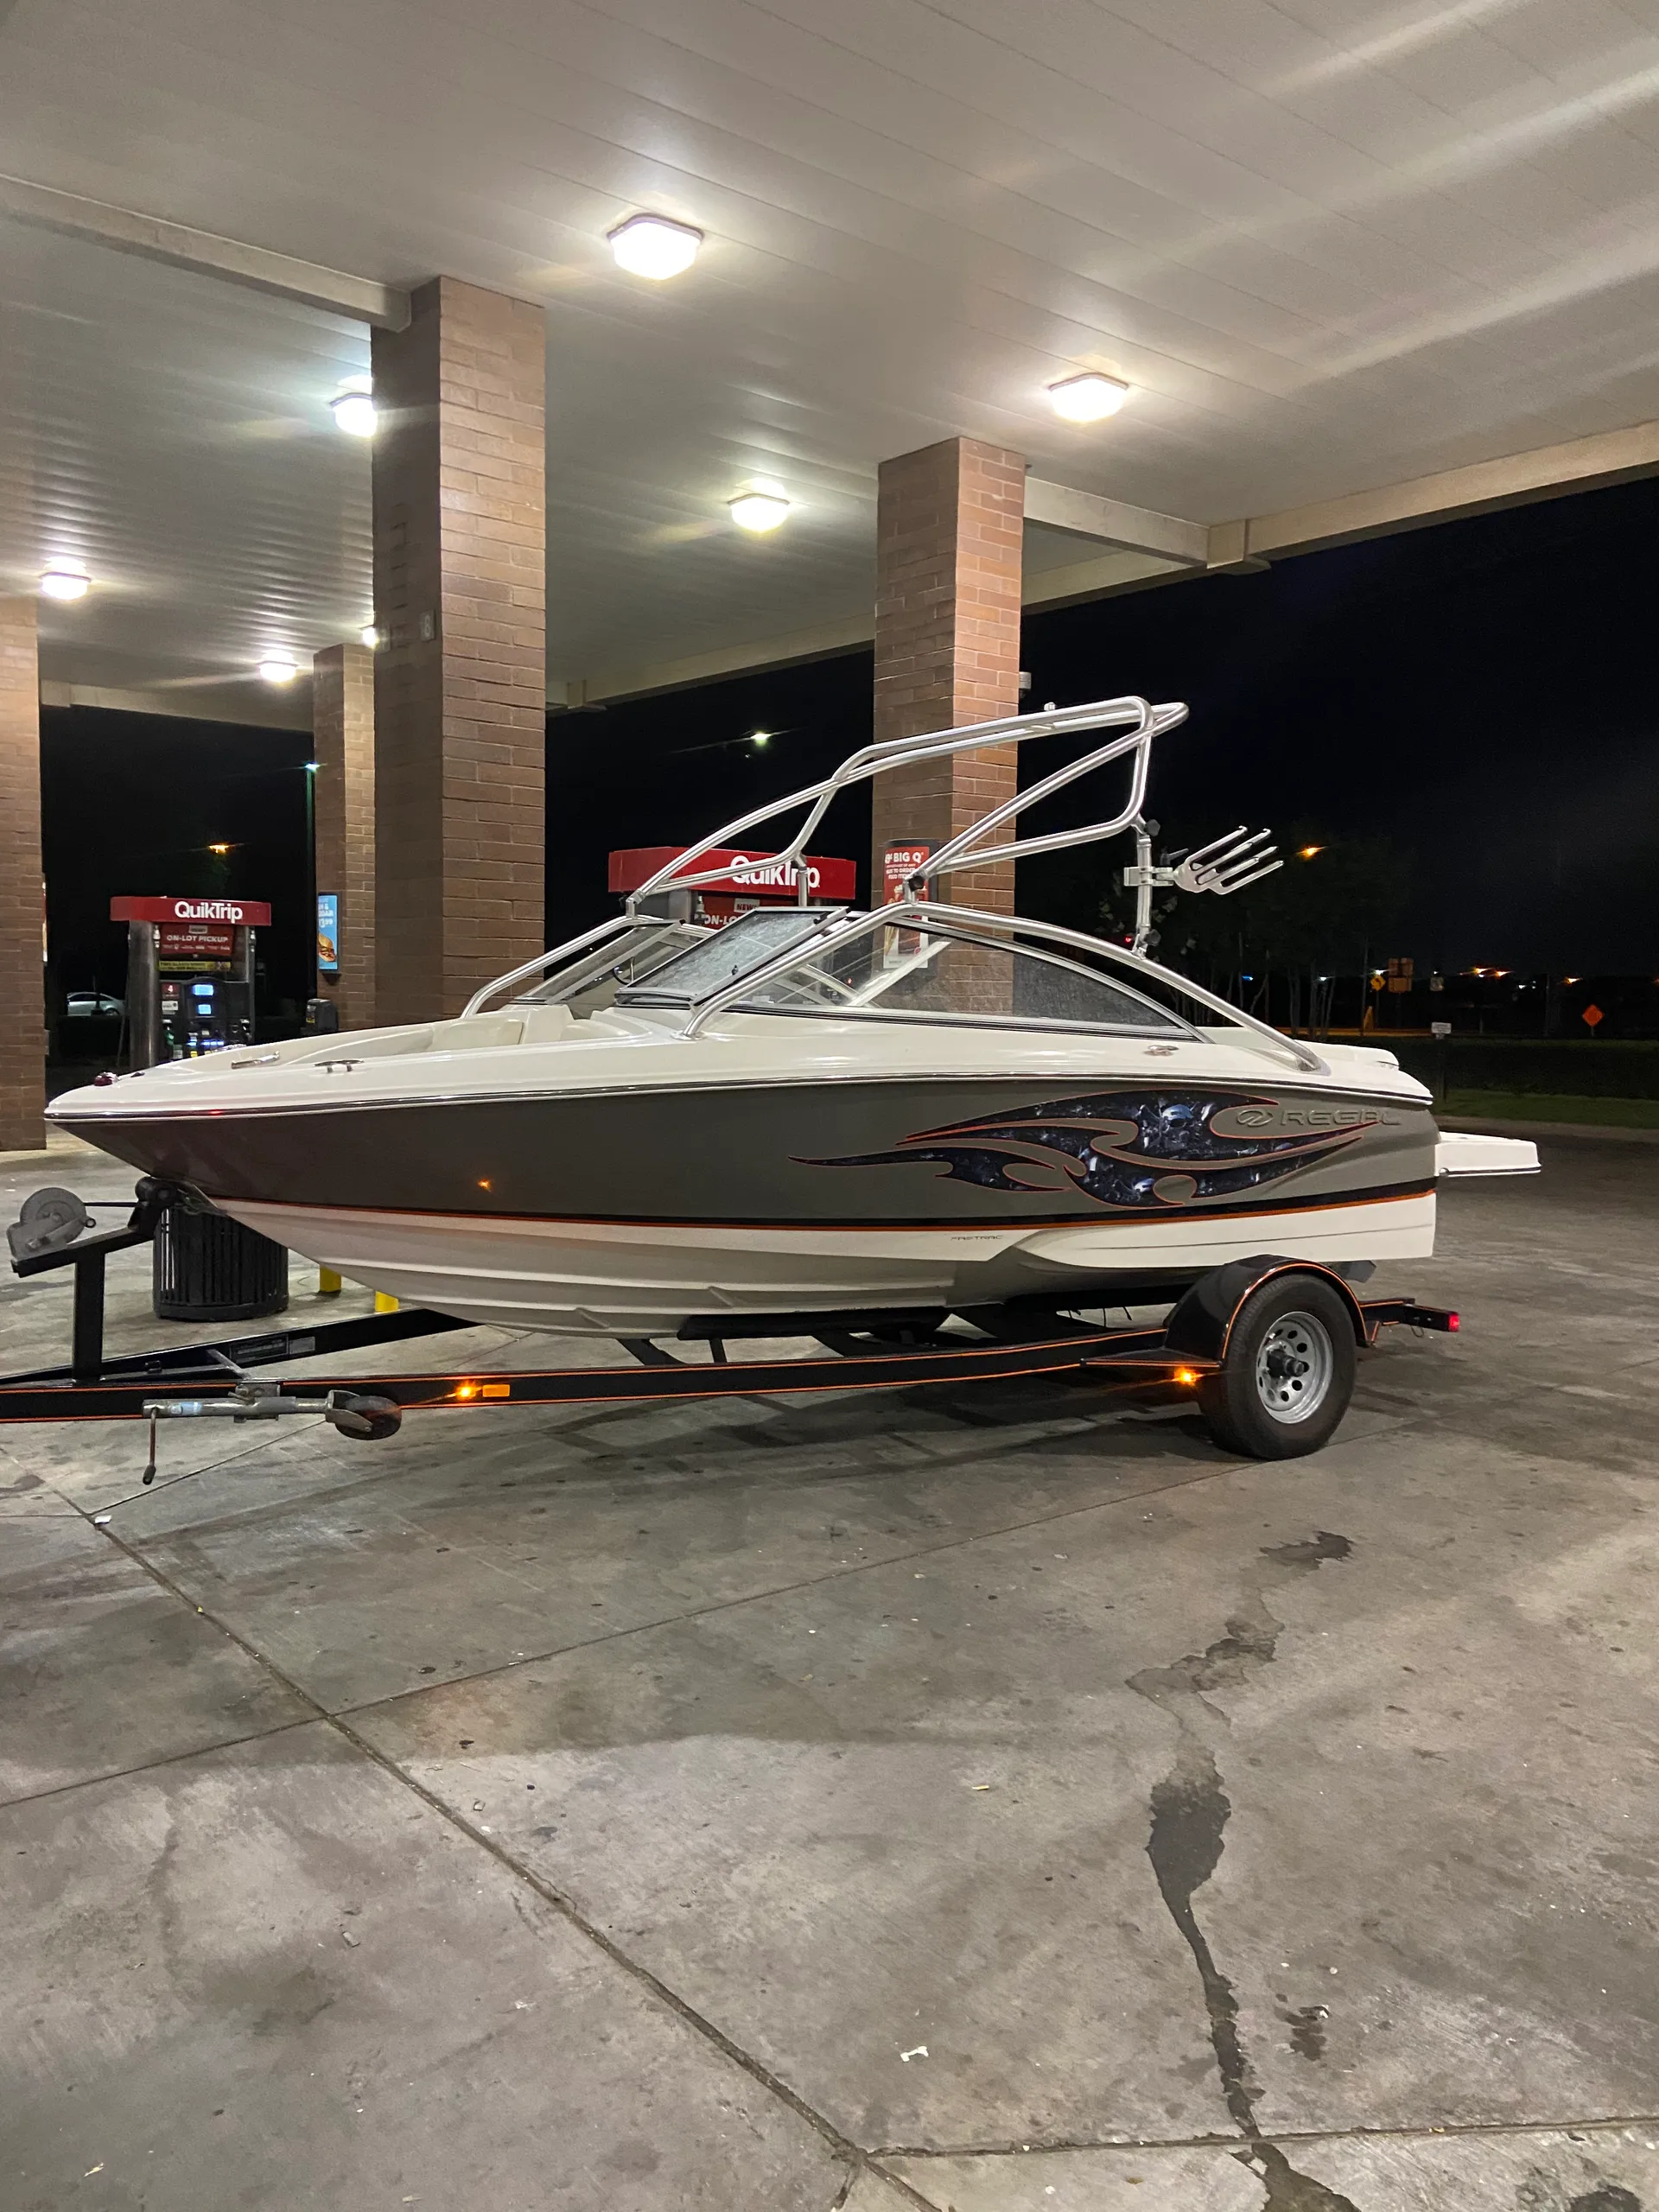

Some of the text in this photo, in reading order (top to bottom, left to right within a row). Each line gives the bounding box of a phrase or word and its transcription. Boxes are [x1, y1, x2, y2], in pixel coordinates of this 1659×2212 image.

[893, 852, 910, 862] BIG
[175, 900, 243, 924] QuikTrip
[167, 984, 174, 993] 4
[1281, 1109, 1401, 1126] REGAL
